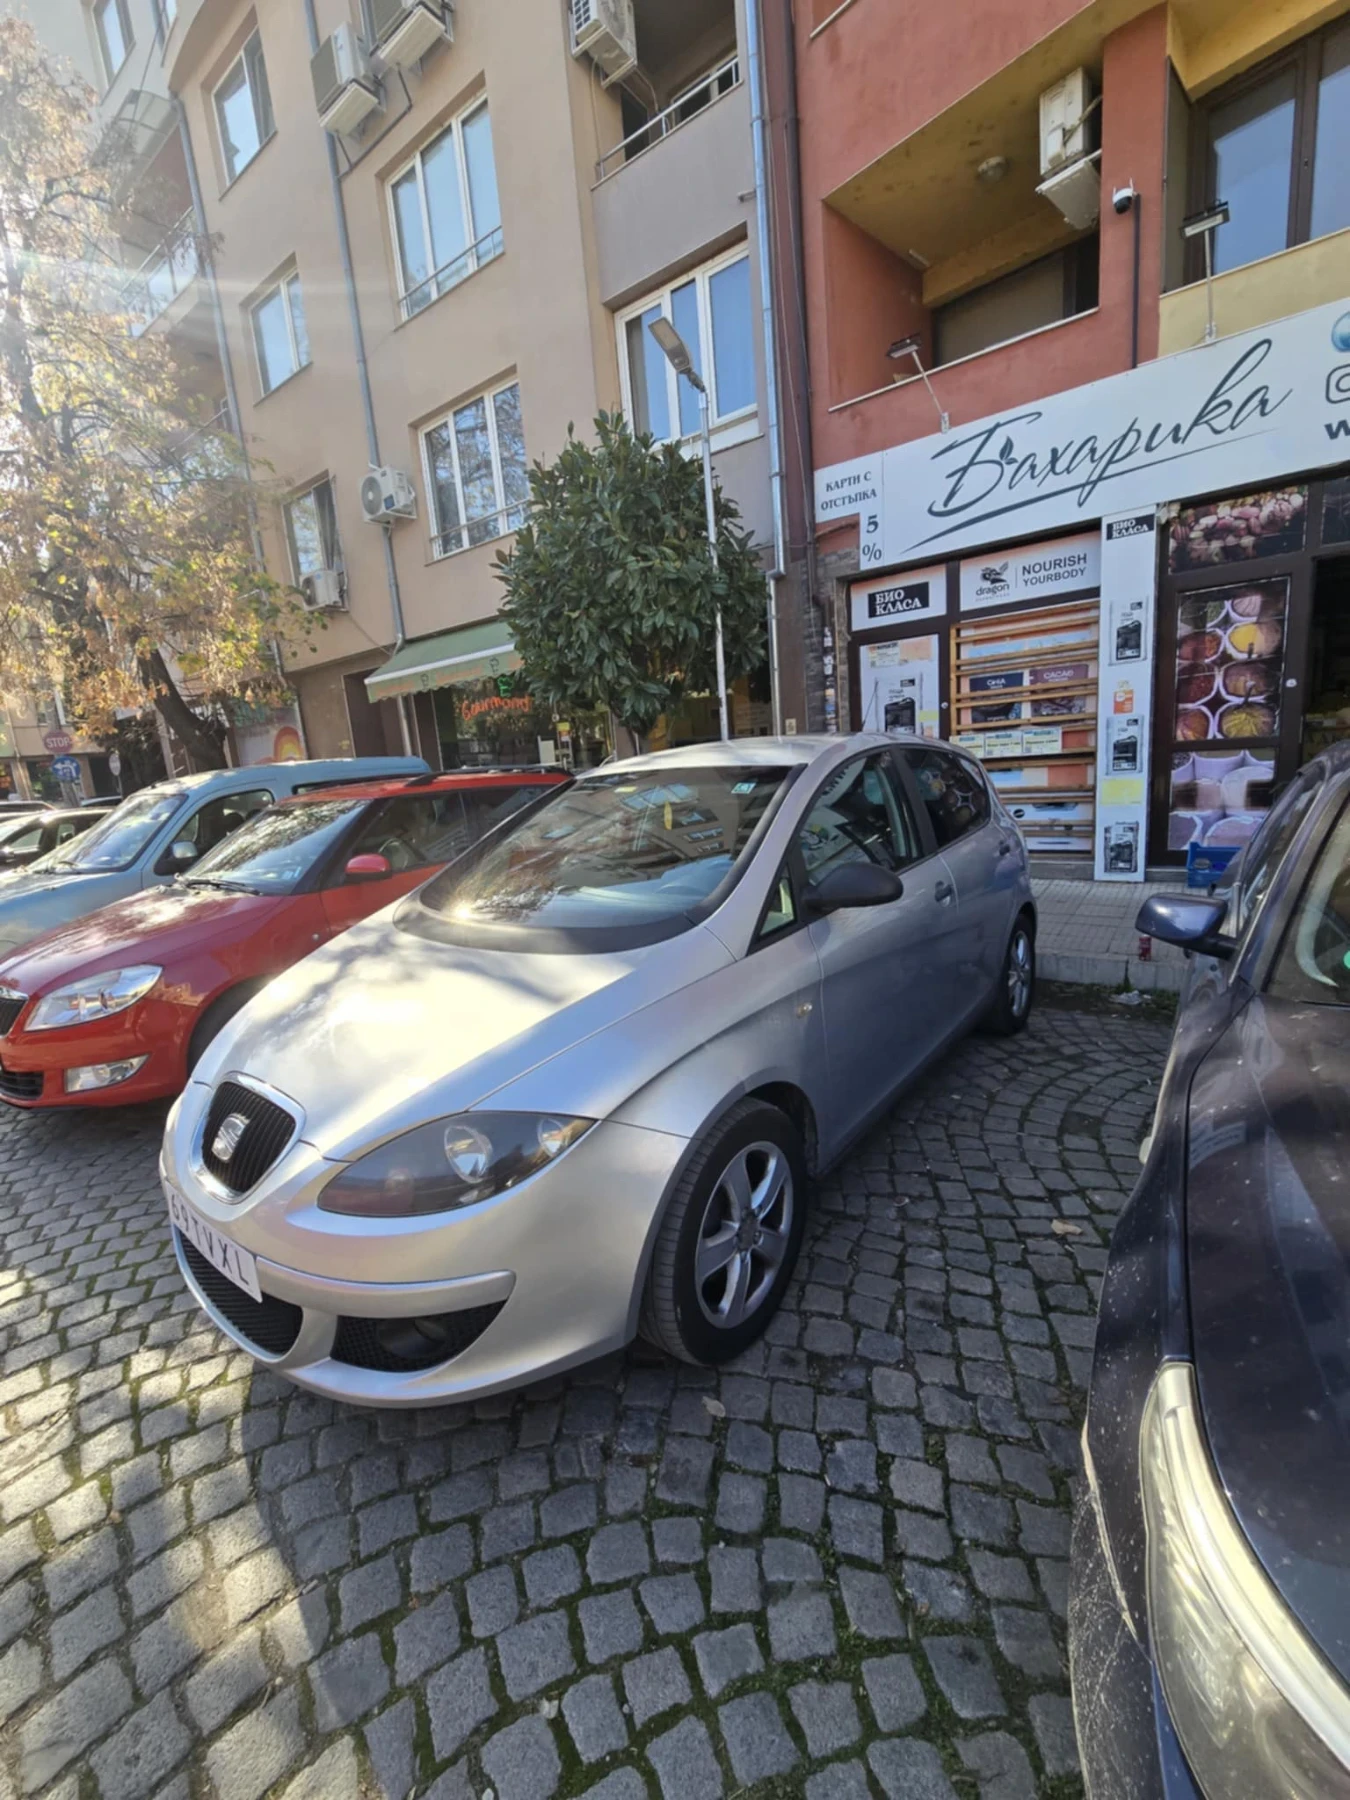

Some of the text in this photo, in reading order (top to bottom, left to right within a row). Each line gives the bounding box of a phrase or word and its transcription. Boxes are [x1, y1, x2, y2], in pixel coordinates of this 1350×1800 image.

[928, 338, 1293, 518] Бахарика
[825, 474, 861, 492] КАРТИ
[820, 488, 878, 511] ОТСТЪПКА
[866, 514, 879, 534] 5
[1112, 524, 1149, 539] КЛАСА
[862, 543, 882, 562] %
[1022, 552, 1087, 576] NOURISH
[1023, 566, 1087, 587] YOURBODY
[875, 589, 905, 604] БИО
[976, 583, 1010, 597] dragon
[876, 597, 922, 615] КЛАСА
[1043, 669, 1074, 679] CACAO
[46, 736, 70, 749] STOP
